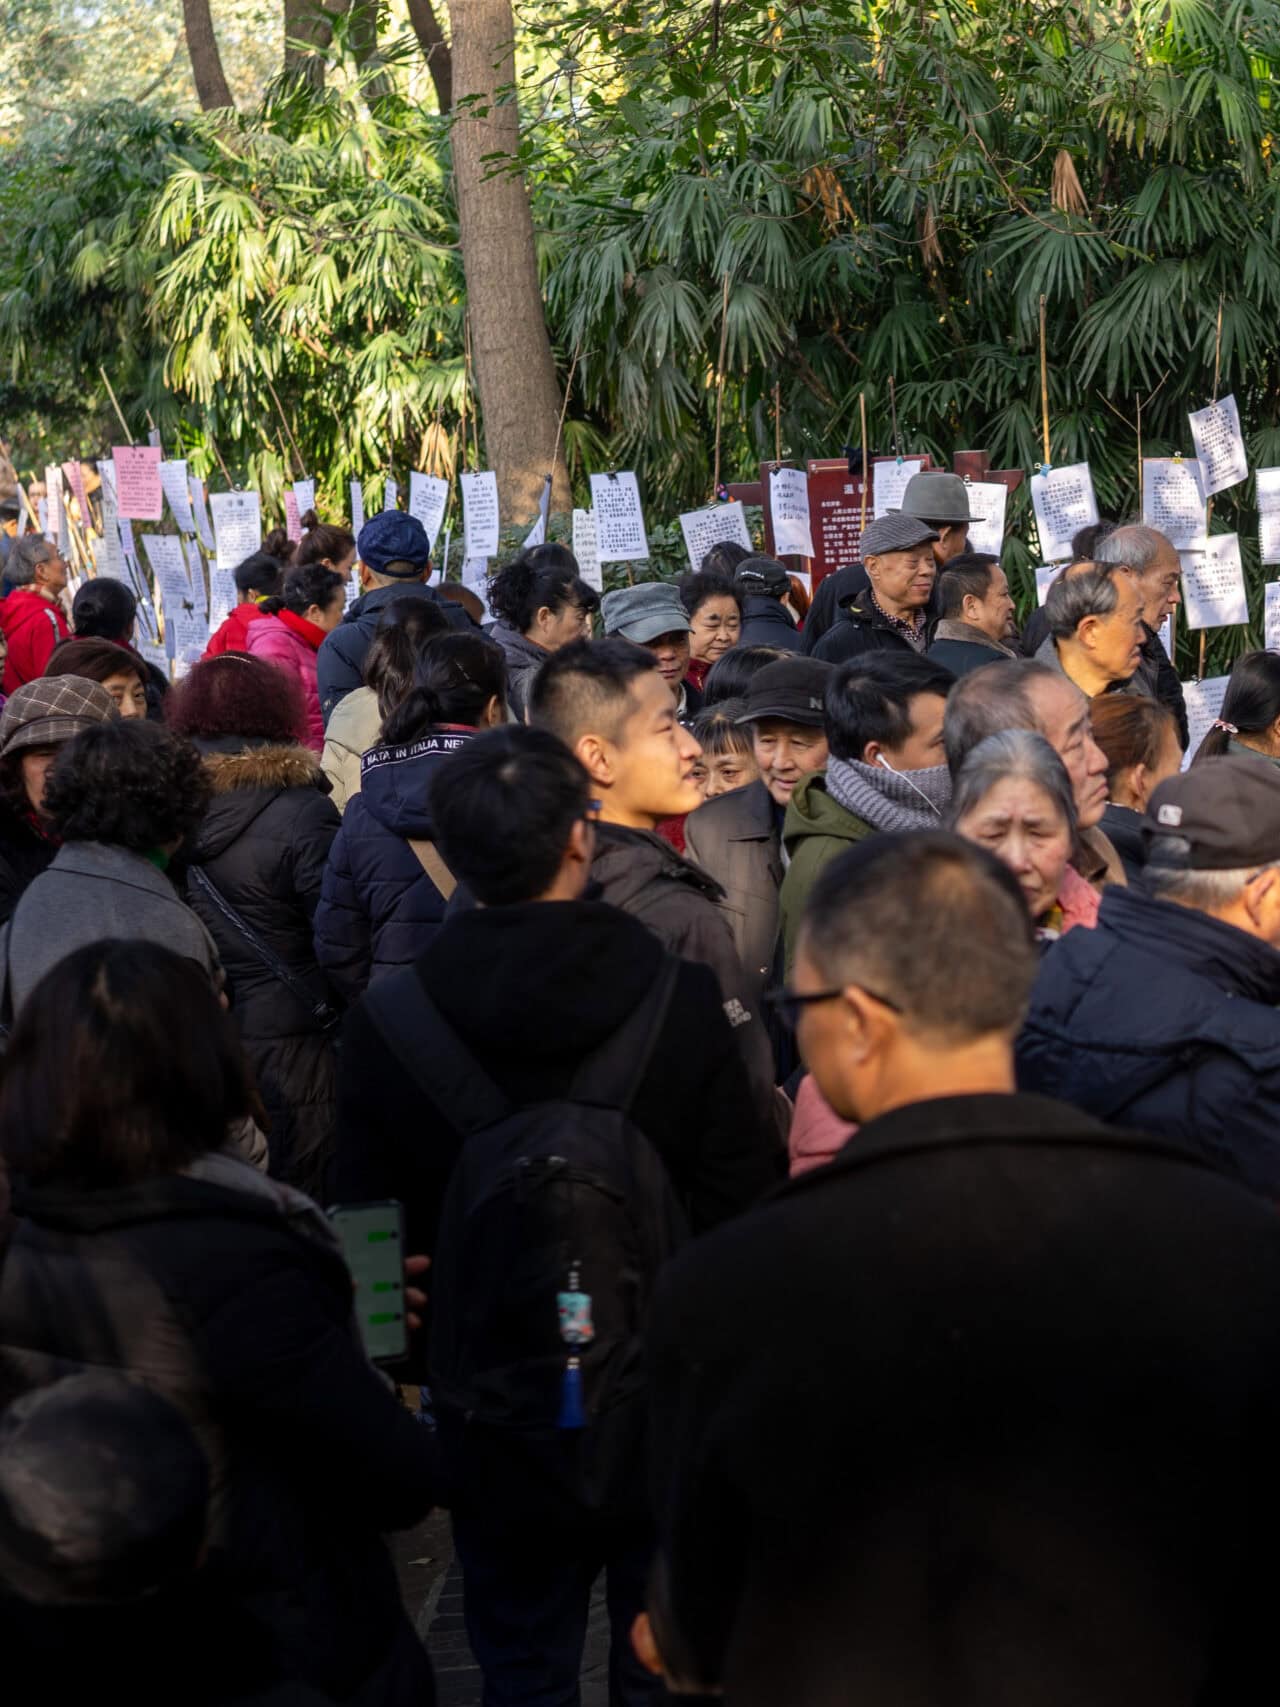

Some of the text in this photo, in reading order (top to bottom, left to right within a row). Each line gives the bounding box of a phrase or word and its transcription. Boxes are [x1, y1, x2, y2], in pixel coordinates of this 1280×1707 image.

[395, 747, 407, 758] IN
[410, 739, 438, 755] ITALIA
[444, 739, 464, 749] NE
